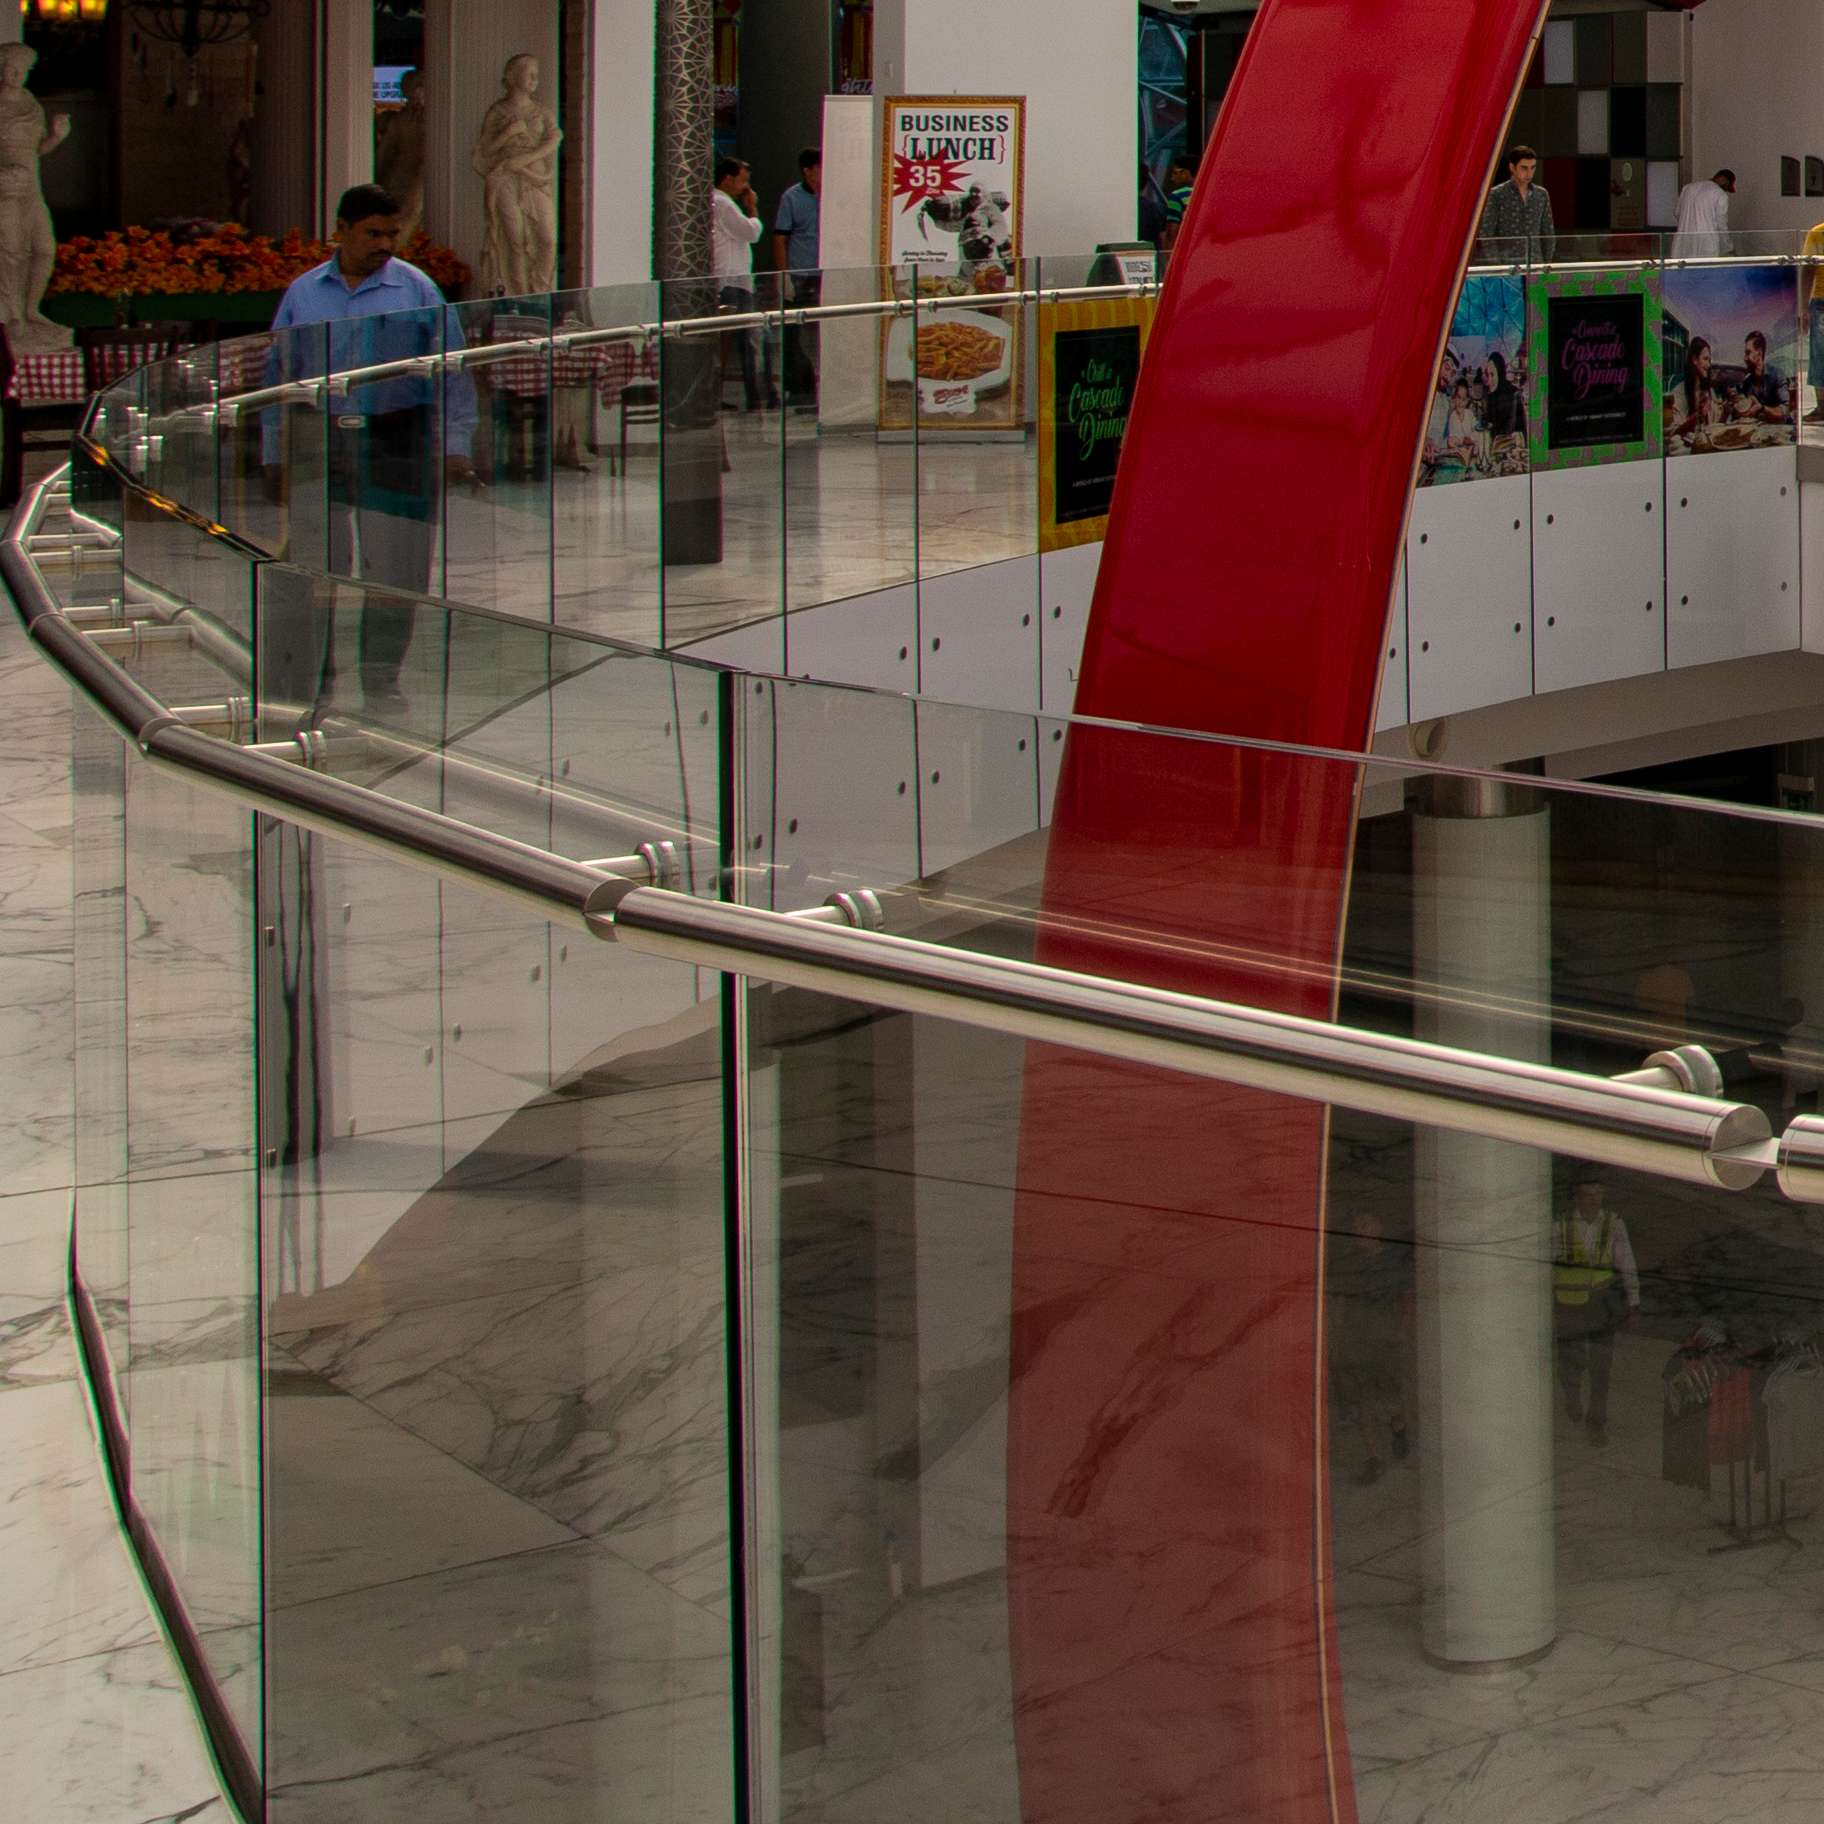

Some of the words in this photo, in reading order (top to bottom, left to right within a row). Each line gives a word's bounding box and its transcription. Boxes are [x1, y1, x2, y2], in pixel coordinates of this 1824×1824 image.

[901, 114, 1009, 133] BUSINESS
[909, 165, 942, 187] 35
[1560, 333, 1626, 371] Cascade
[1068, 375, 1127, 423] Cascade
[1573, 361, 1631, 401] Dining
